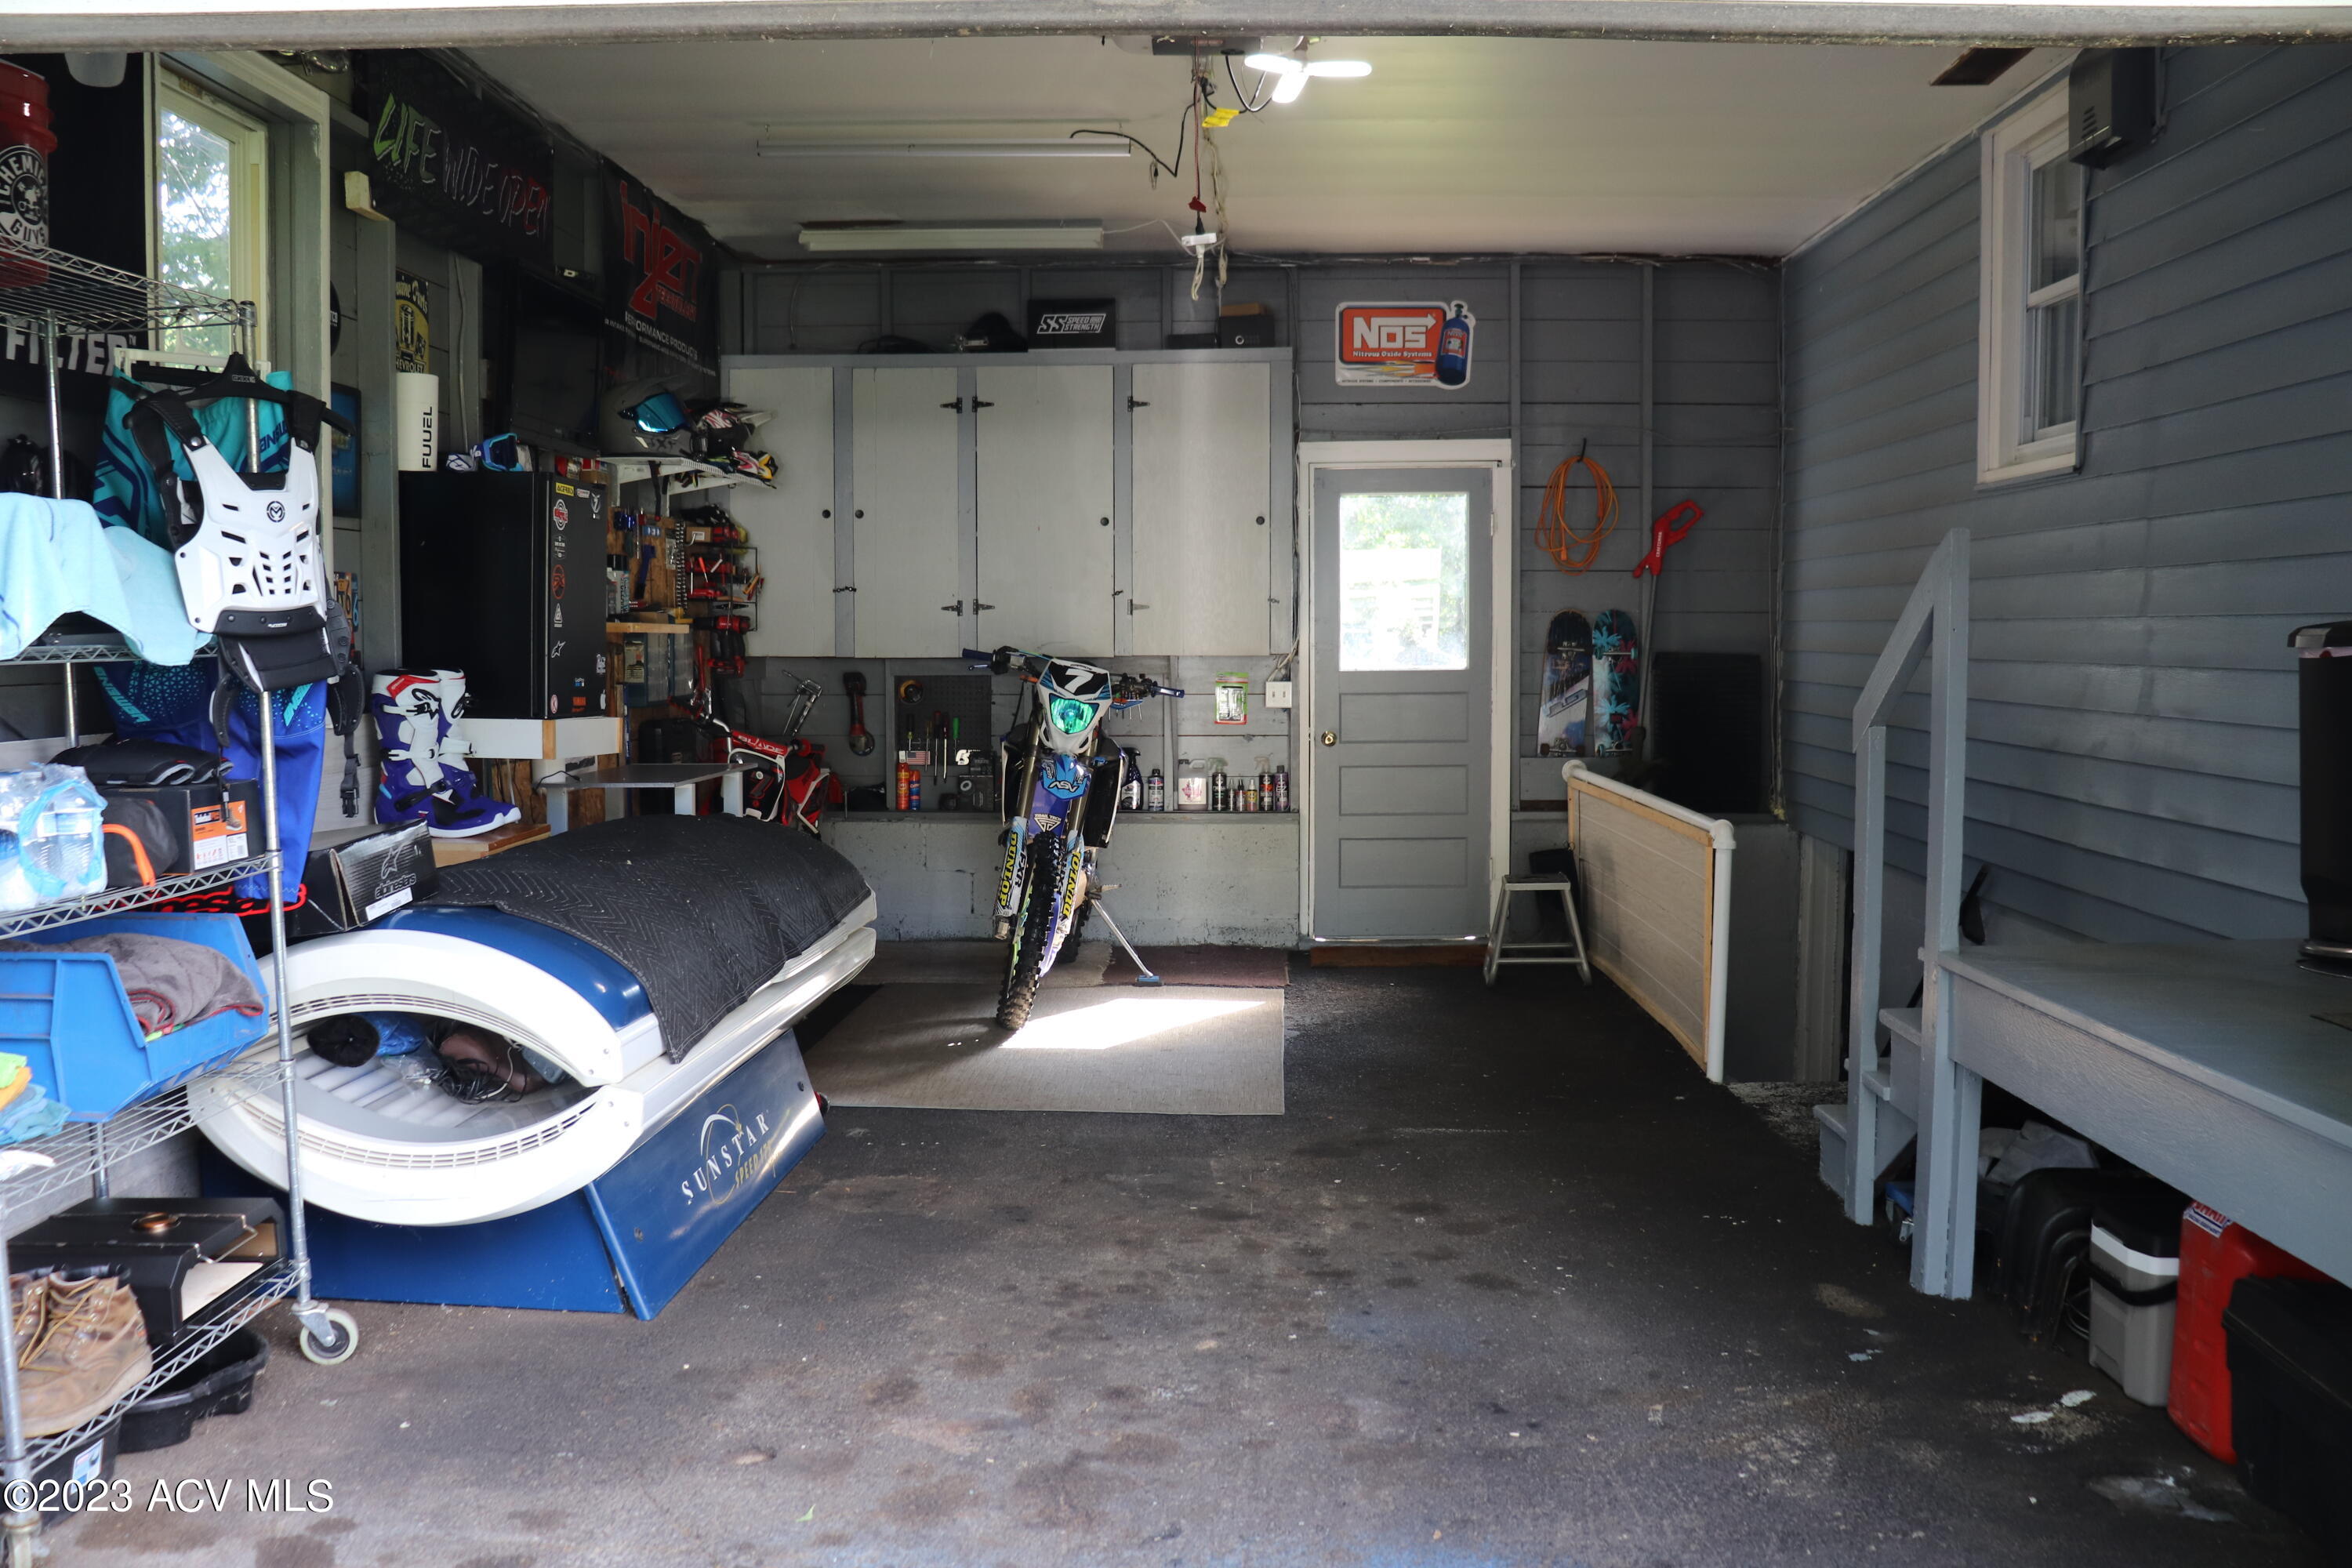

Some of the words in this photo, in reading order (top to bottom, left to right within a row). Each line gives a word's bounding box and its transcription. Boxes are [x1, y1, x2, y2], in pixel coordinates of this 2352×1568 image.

[373, 93, 441, 185] LIFE
[10, 218, 45, 245] GUYS
[6, 317, 127, 377] FITER
[1353, 314, 1436, 348] NOS
[396, 359, 426, 373] HEVROLET
[422, 406, 432, 468] FUUEL
[1064, 668, 1094, 694] 7
[1000, 832, 1018, 907] DUNLOP
[1015, 852, 1026, 887] FXR
[681, 1112, 770, 1203] SUNSTAR
[735, 1153, 759, 1189] SPEED
